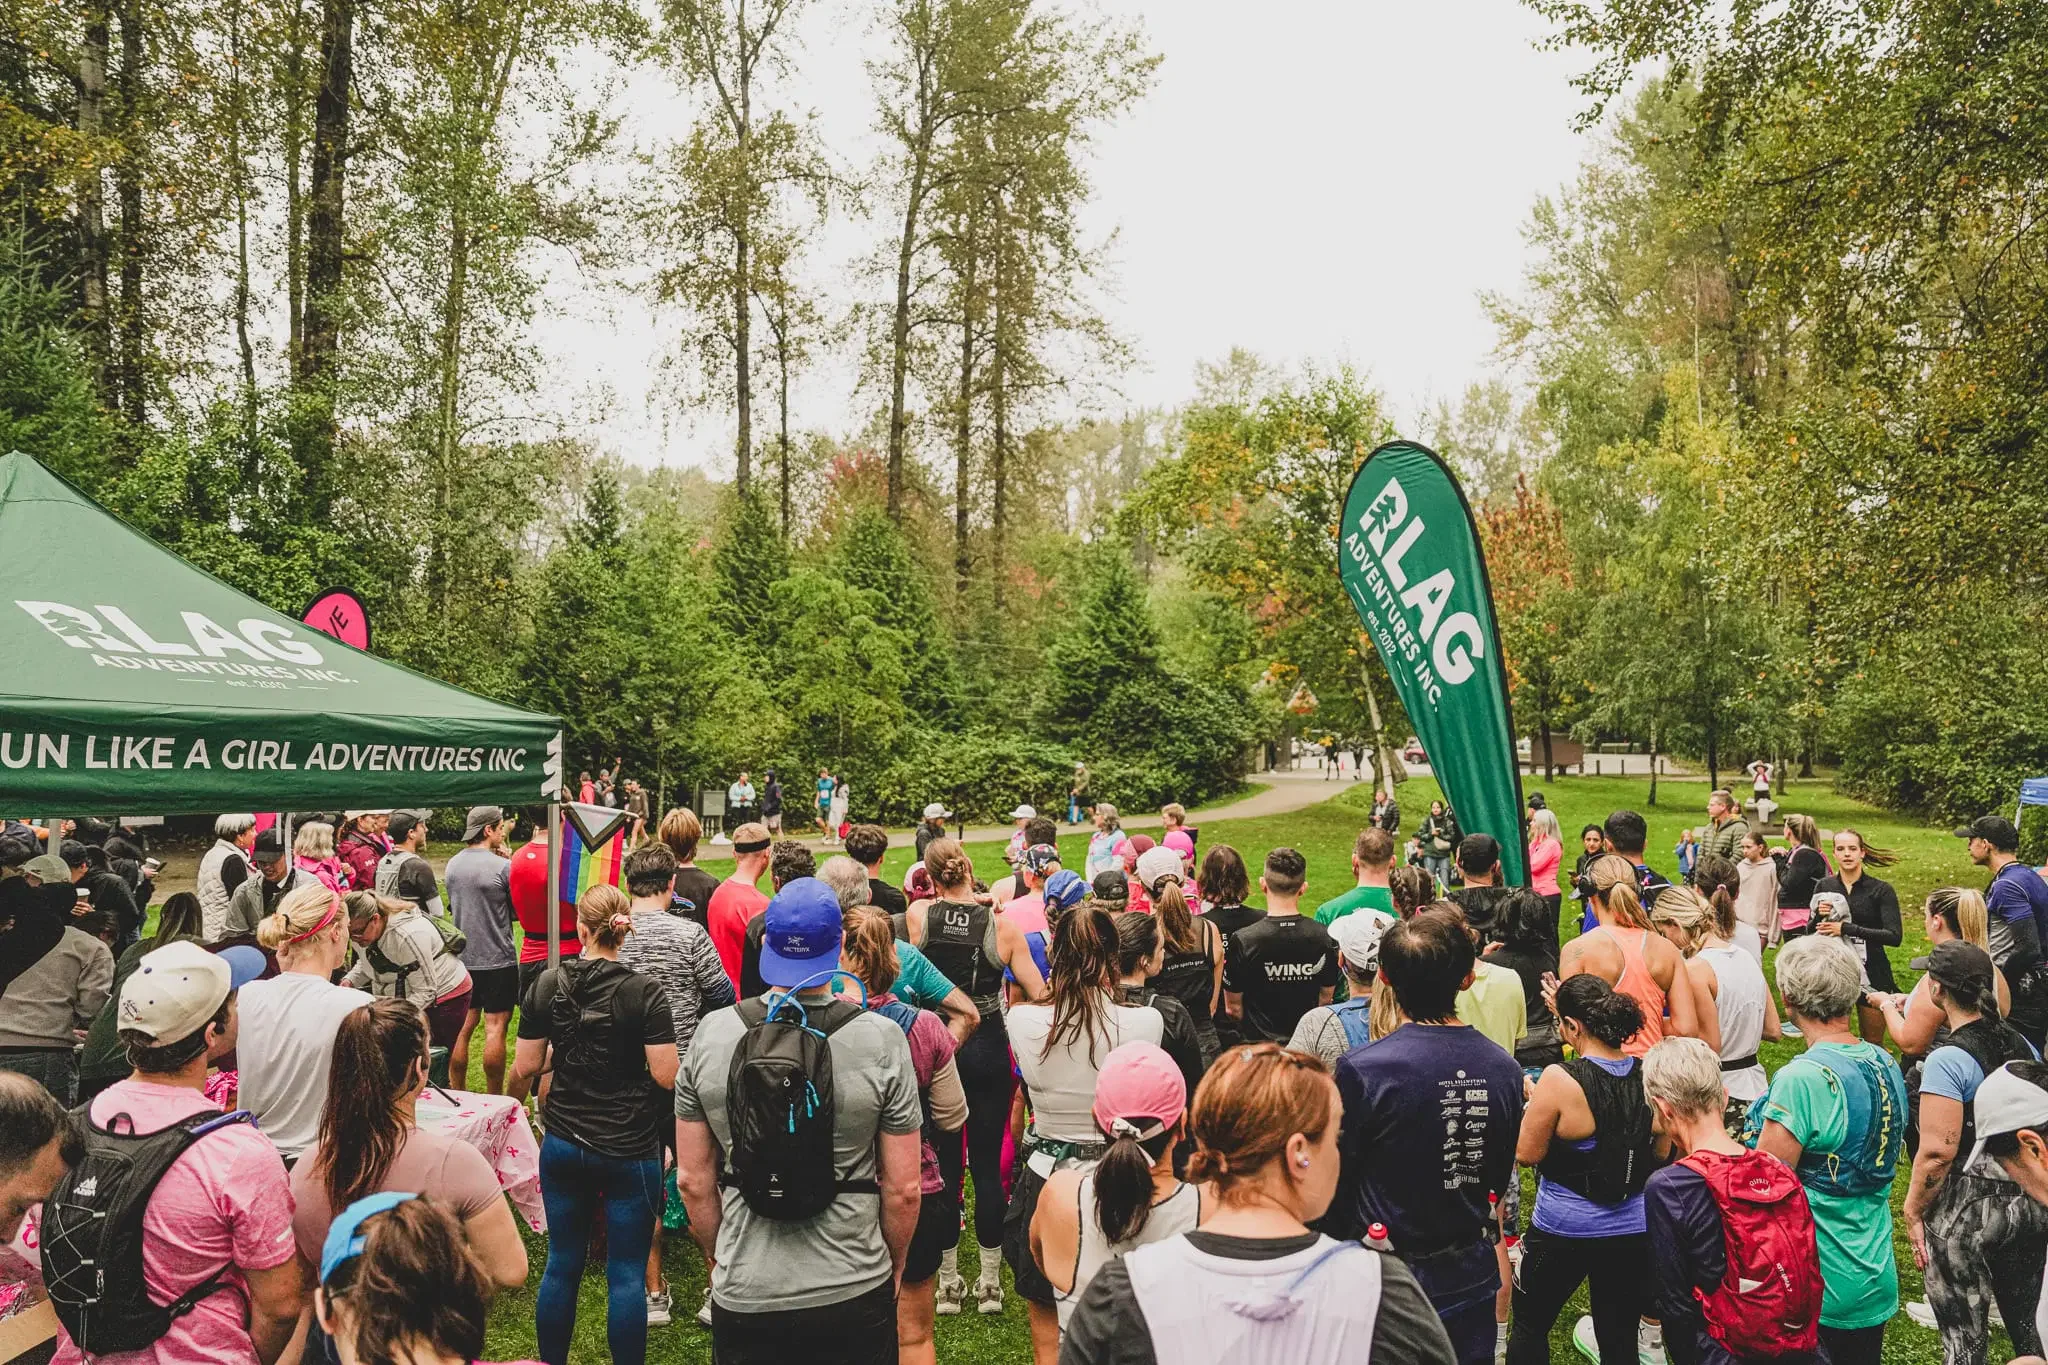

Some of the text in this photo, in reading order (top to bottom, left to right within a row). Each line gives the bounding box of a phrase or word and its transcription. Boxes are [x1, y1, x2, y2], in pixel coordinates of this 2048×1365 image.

[1359, 476, 1484, 685] RLAG
[15, 600, 324, 665] RLAG
[1345, 532, 1441, 712] ADVENTURES INC.
[1367, 610, 1397, 657] est. 2012
[91, 653, 360, 684] ADVENTURES INC.
[253, 680, 293, 689] 2012
[85, 735, 176, 769] LIKE
[183, 738, 212, 769] A
[221, 739, 297, 770] GIRL
[304, 743, 485, 772] ADVENTURES
[488, 748, 527, 772] INC
[1264, 963, 1313, 977] WING
